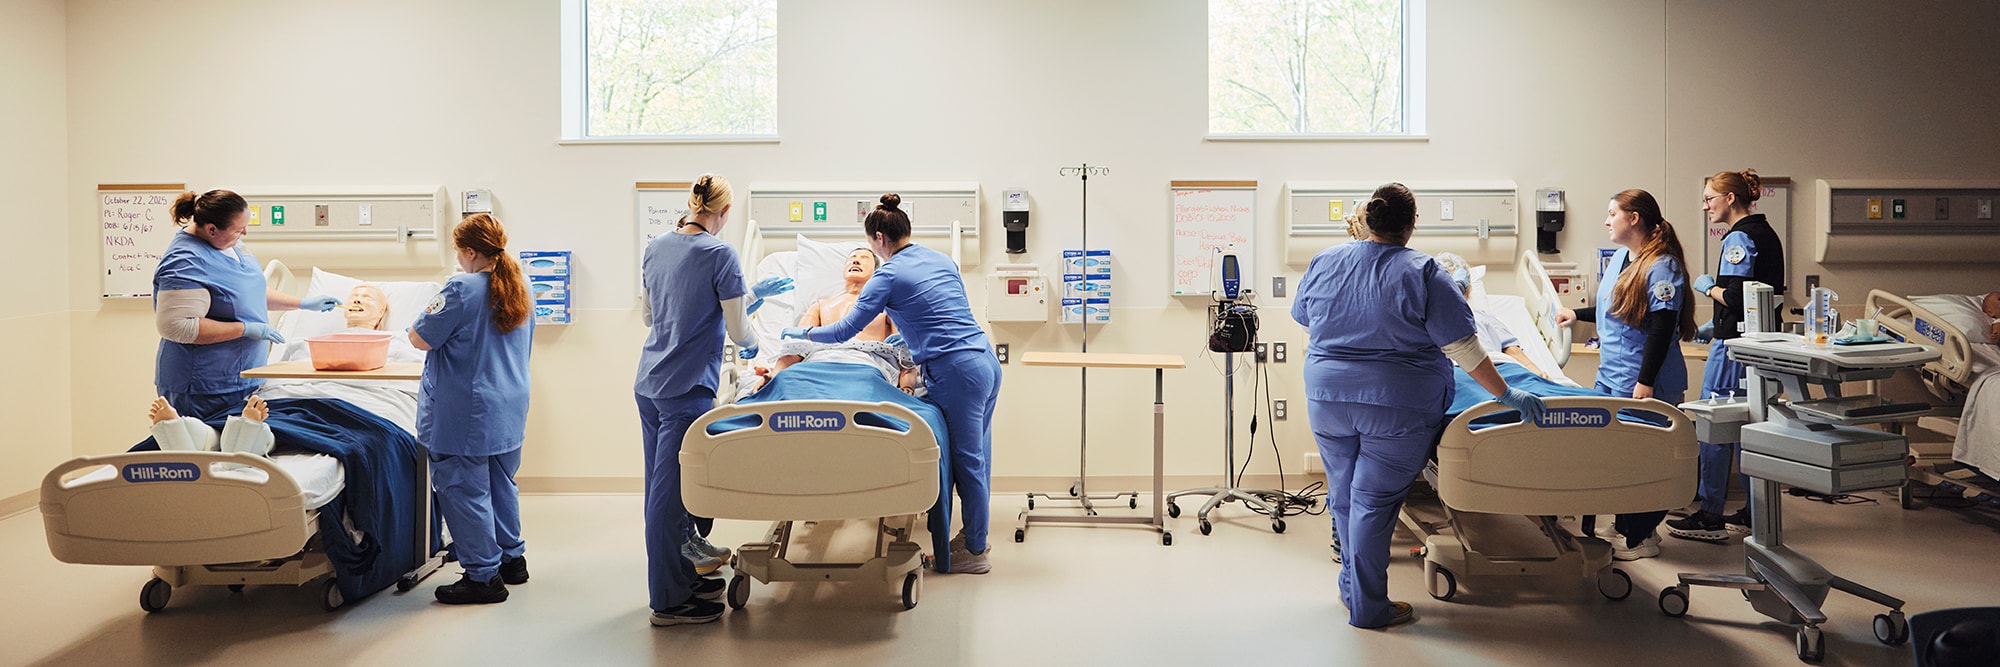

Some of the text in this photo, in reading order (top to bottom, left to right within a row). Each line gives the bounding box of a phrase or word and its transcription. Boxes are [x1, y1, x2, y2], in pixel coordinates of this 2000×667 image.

[104, 195, 130, 206] October
[148, 195, 168, 206] 2025
[117, 208, 141, 222] Roger
[105, 235, 135, 247] NKDA
[778, 415, 838, 429] Hill-Rom
[1542, 411, 1603, 425] Hill-Rom
[130, 466, 193, 480] Hill-Rom
